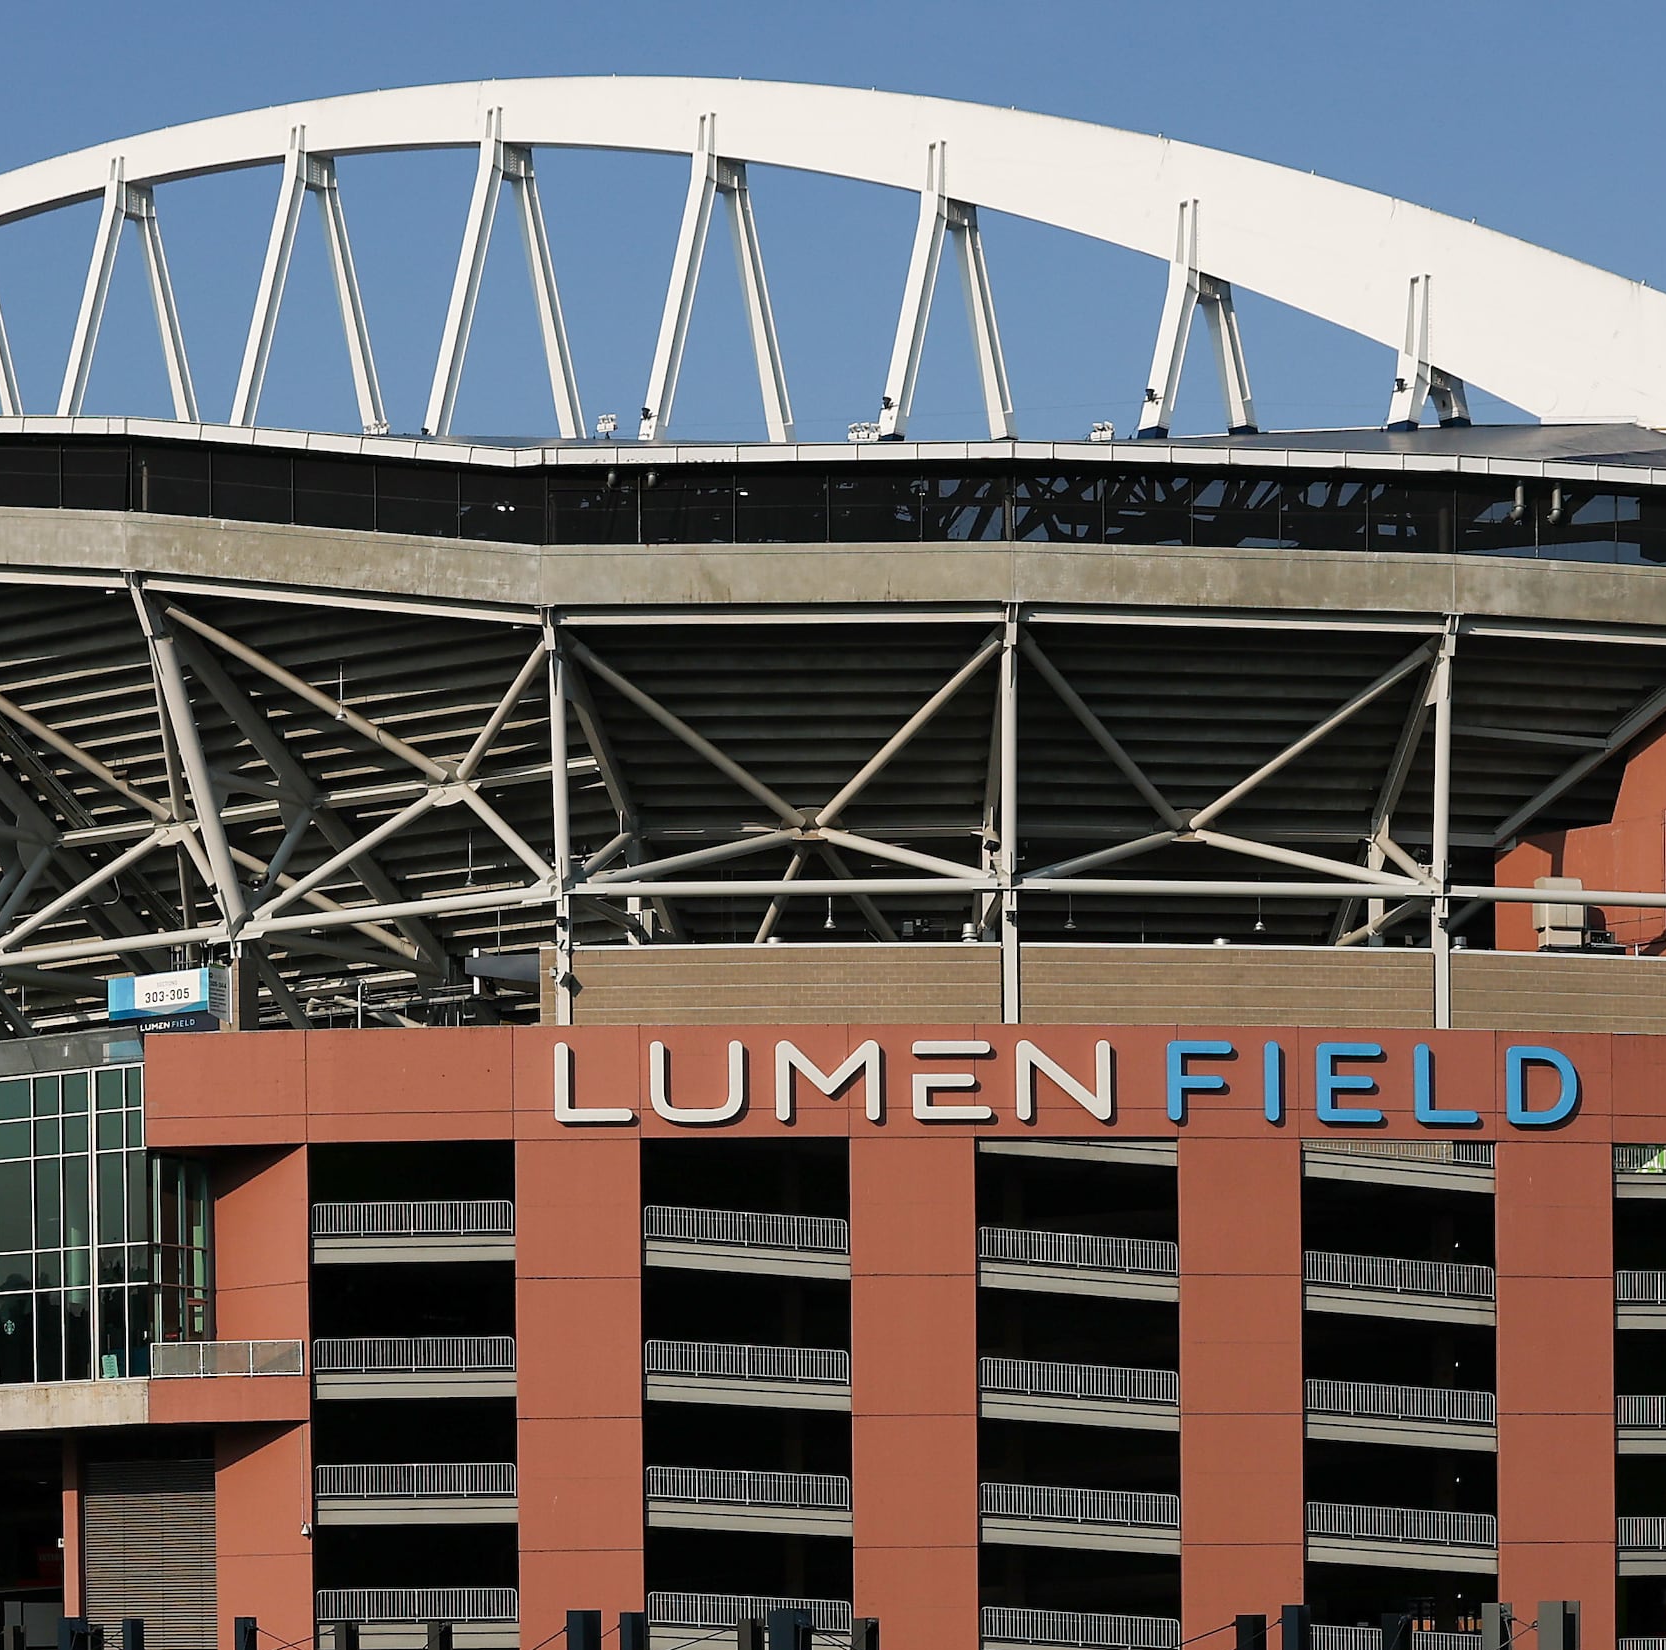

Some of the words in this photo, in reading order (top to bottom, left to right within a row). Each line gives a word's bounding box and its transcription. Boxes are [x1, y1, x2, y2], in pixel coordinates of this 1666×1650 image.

[145, 988, 190, 1004] 303-305
[139, 1021, 171, 1032] LUMEN
[172, 1018, 196, 1028] FIELD
[554, 1038, 1112, 1124] LUMEN
[1165, 1039, 1579, 1127] FIELD
